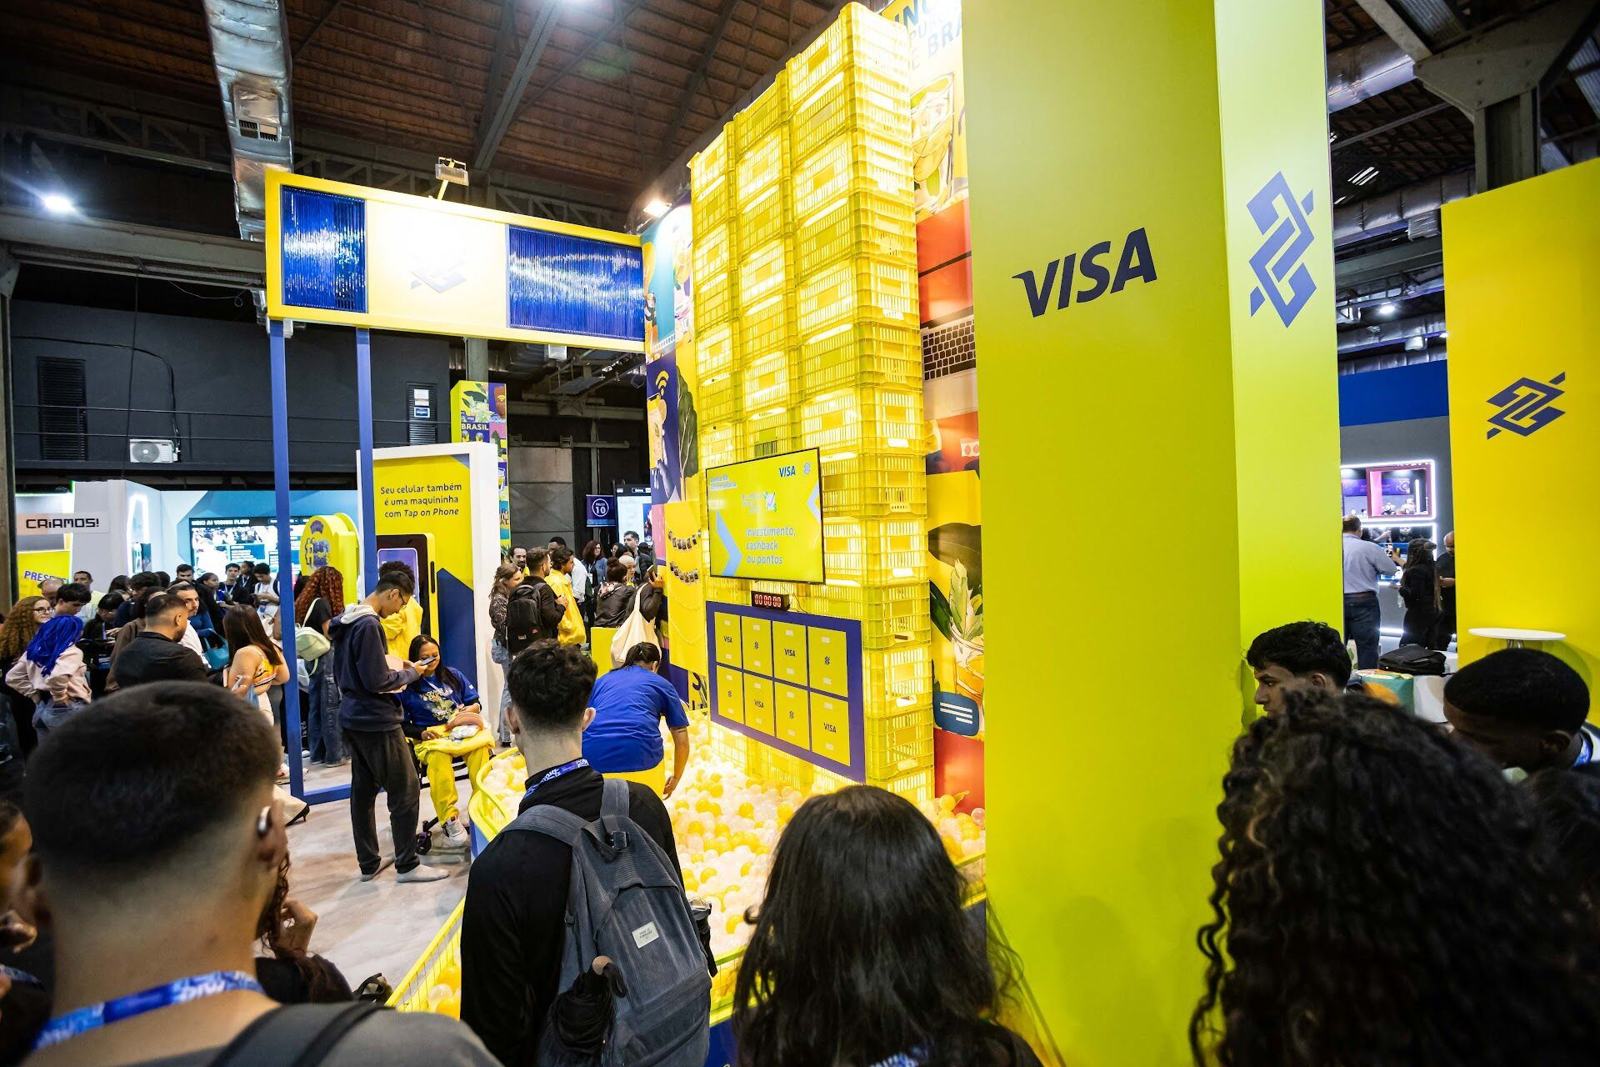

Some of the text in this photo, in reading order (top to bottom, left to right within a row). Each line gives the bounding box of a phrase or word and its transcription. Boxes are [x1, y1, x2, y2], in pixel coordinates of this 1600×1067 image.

[1012, 228, 1157, 317] VISA
[461, 423, 489, 431] BRASIL
[779, 465, 796, 477] VISA
[380, 483, 462, 494] Seu celular também
[410, 495, 459, 506] maquininha
[404, 509, 418, 518] Tap
[432, 507, 459, 516] Phone
[595, 506, 606, 514] 10
[783, 648, 796, 657] VISA
[823, 722, 837, 733] VISA
